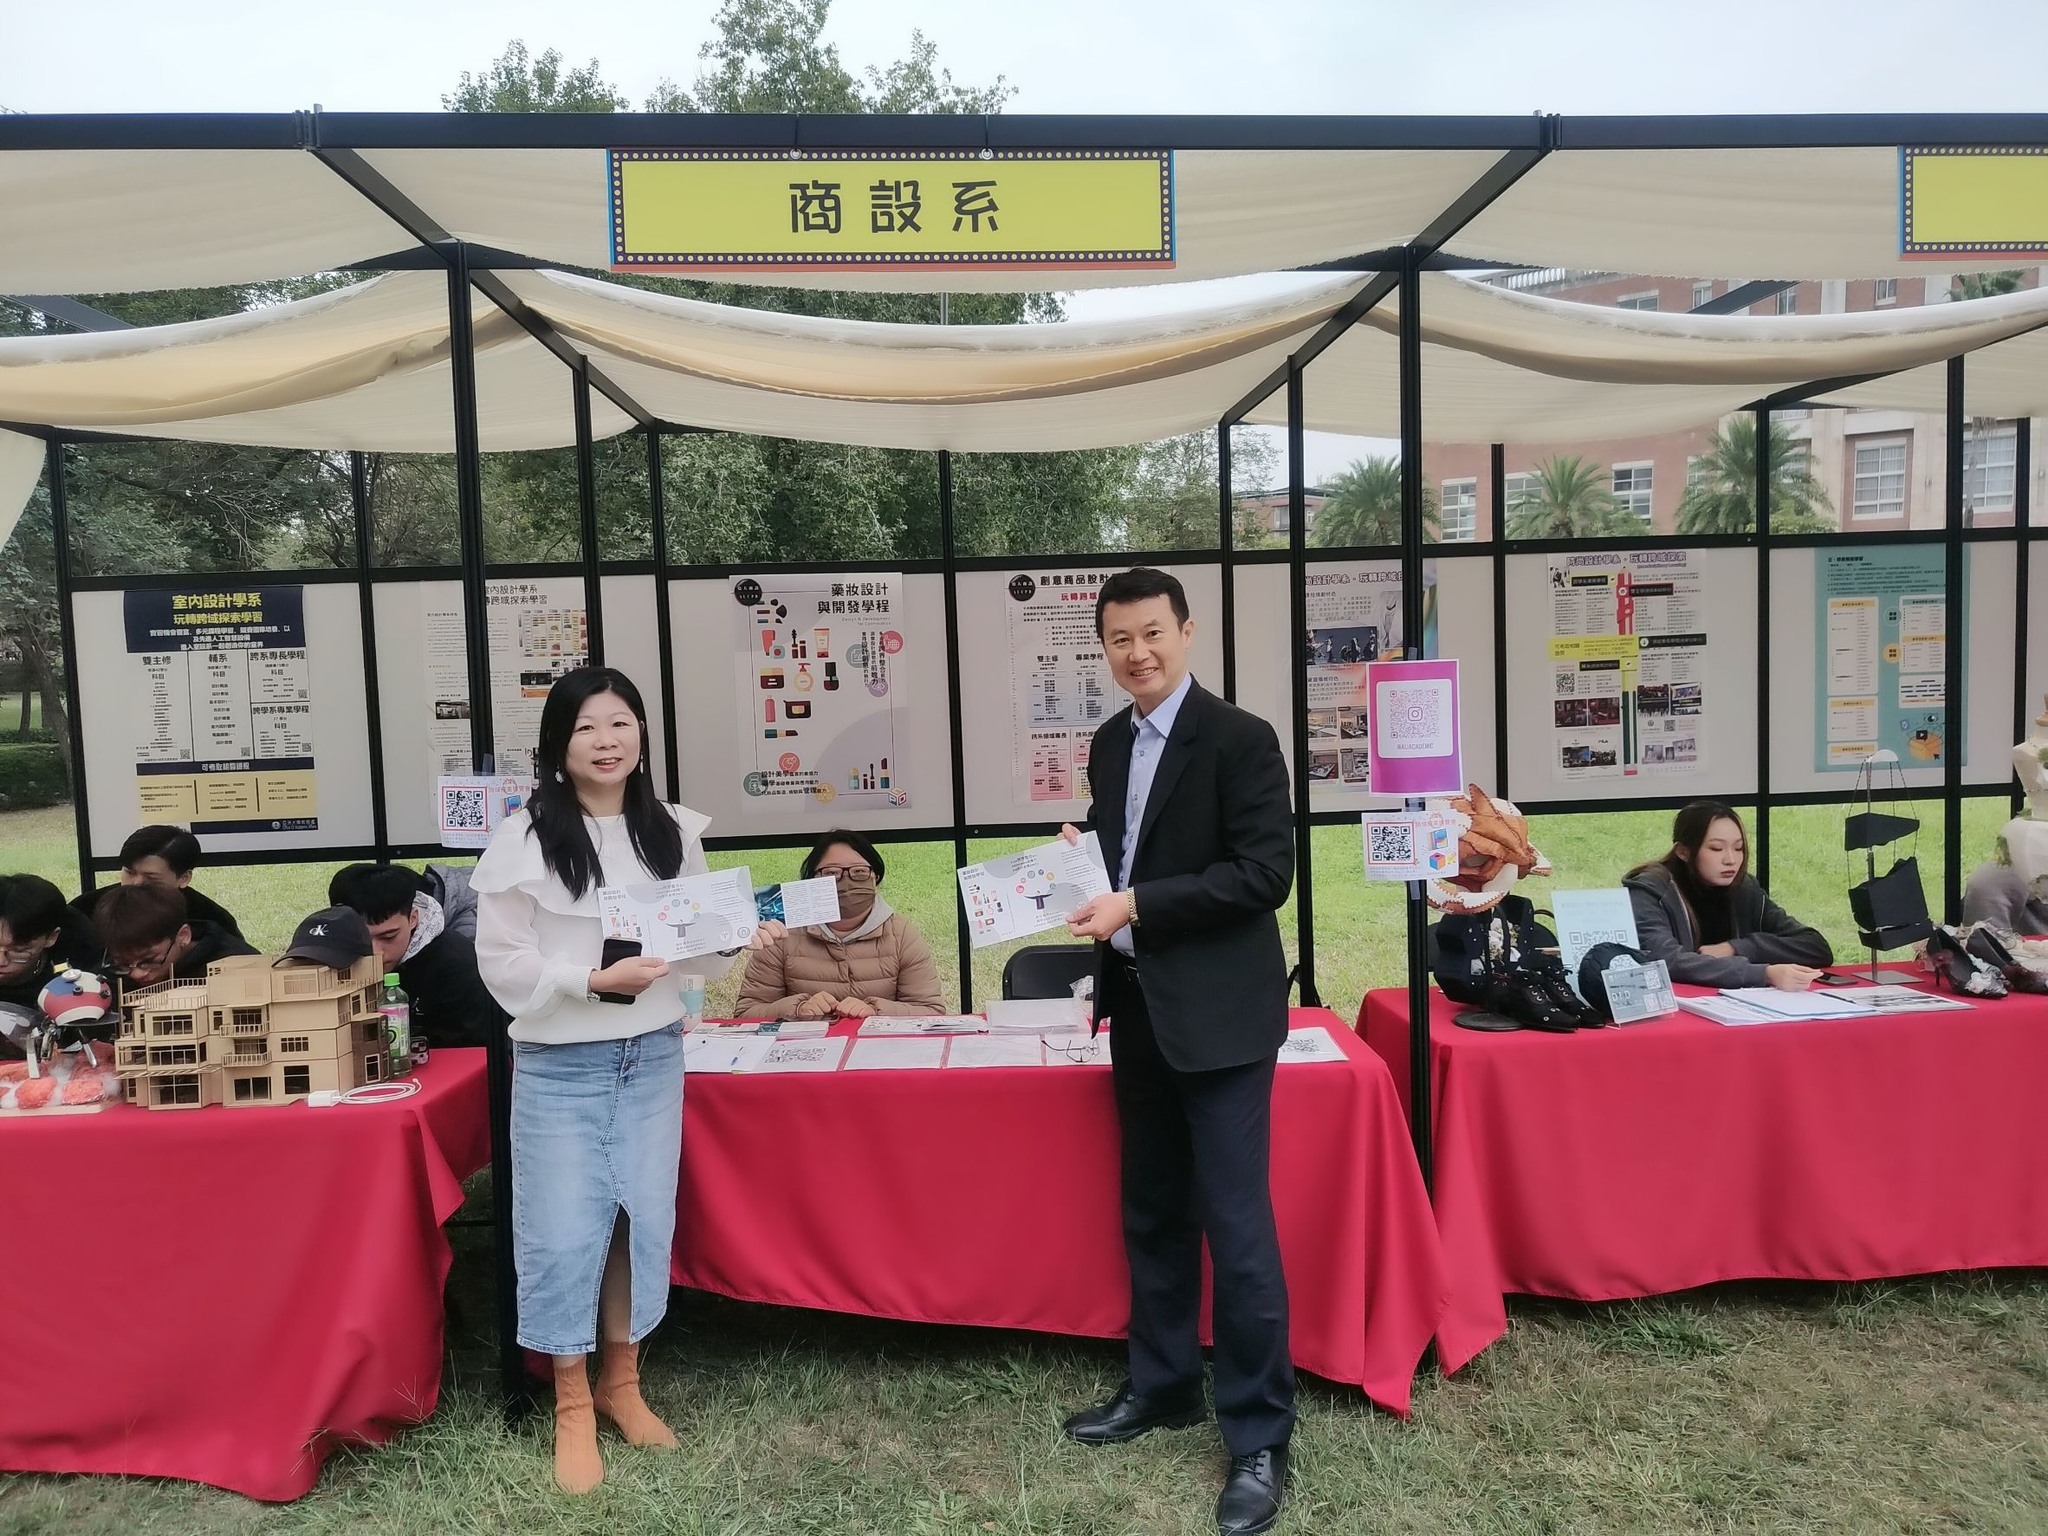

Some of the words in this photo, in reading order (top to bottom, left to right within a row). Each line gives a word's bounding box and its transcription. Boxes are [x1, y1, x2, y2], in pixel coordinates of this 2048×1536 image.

[789, 180, 999, 233] 商設系
[172, 592, 262, 610] 室內設計學系
[817, 600, 890, 614] 與開發學程
[173, 611, 263, 625] 玩轉跨域探索學習
[250, 650, 306, 661] 跨系專長學程
